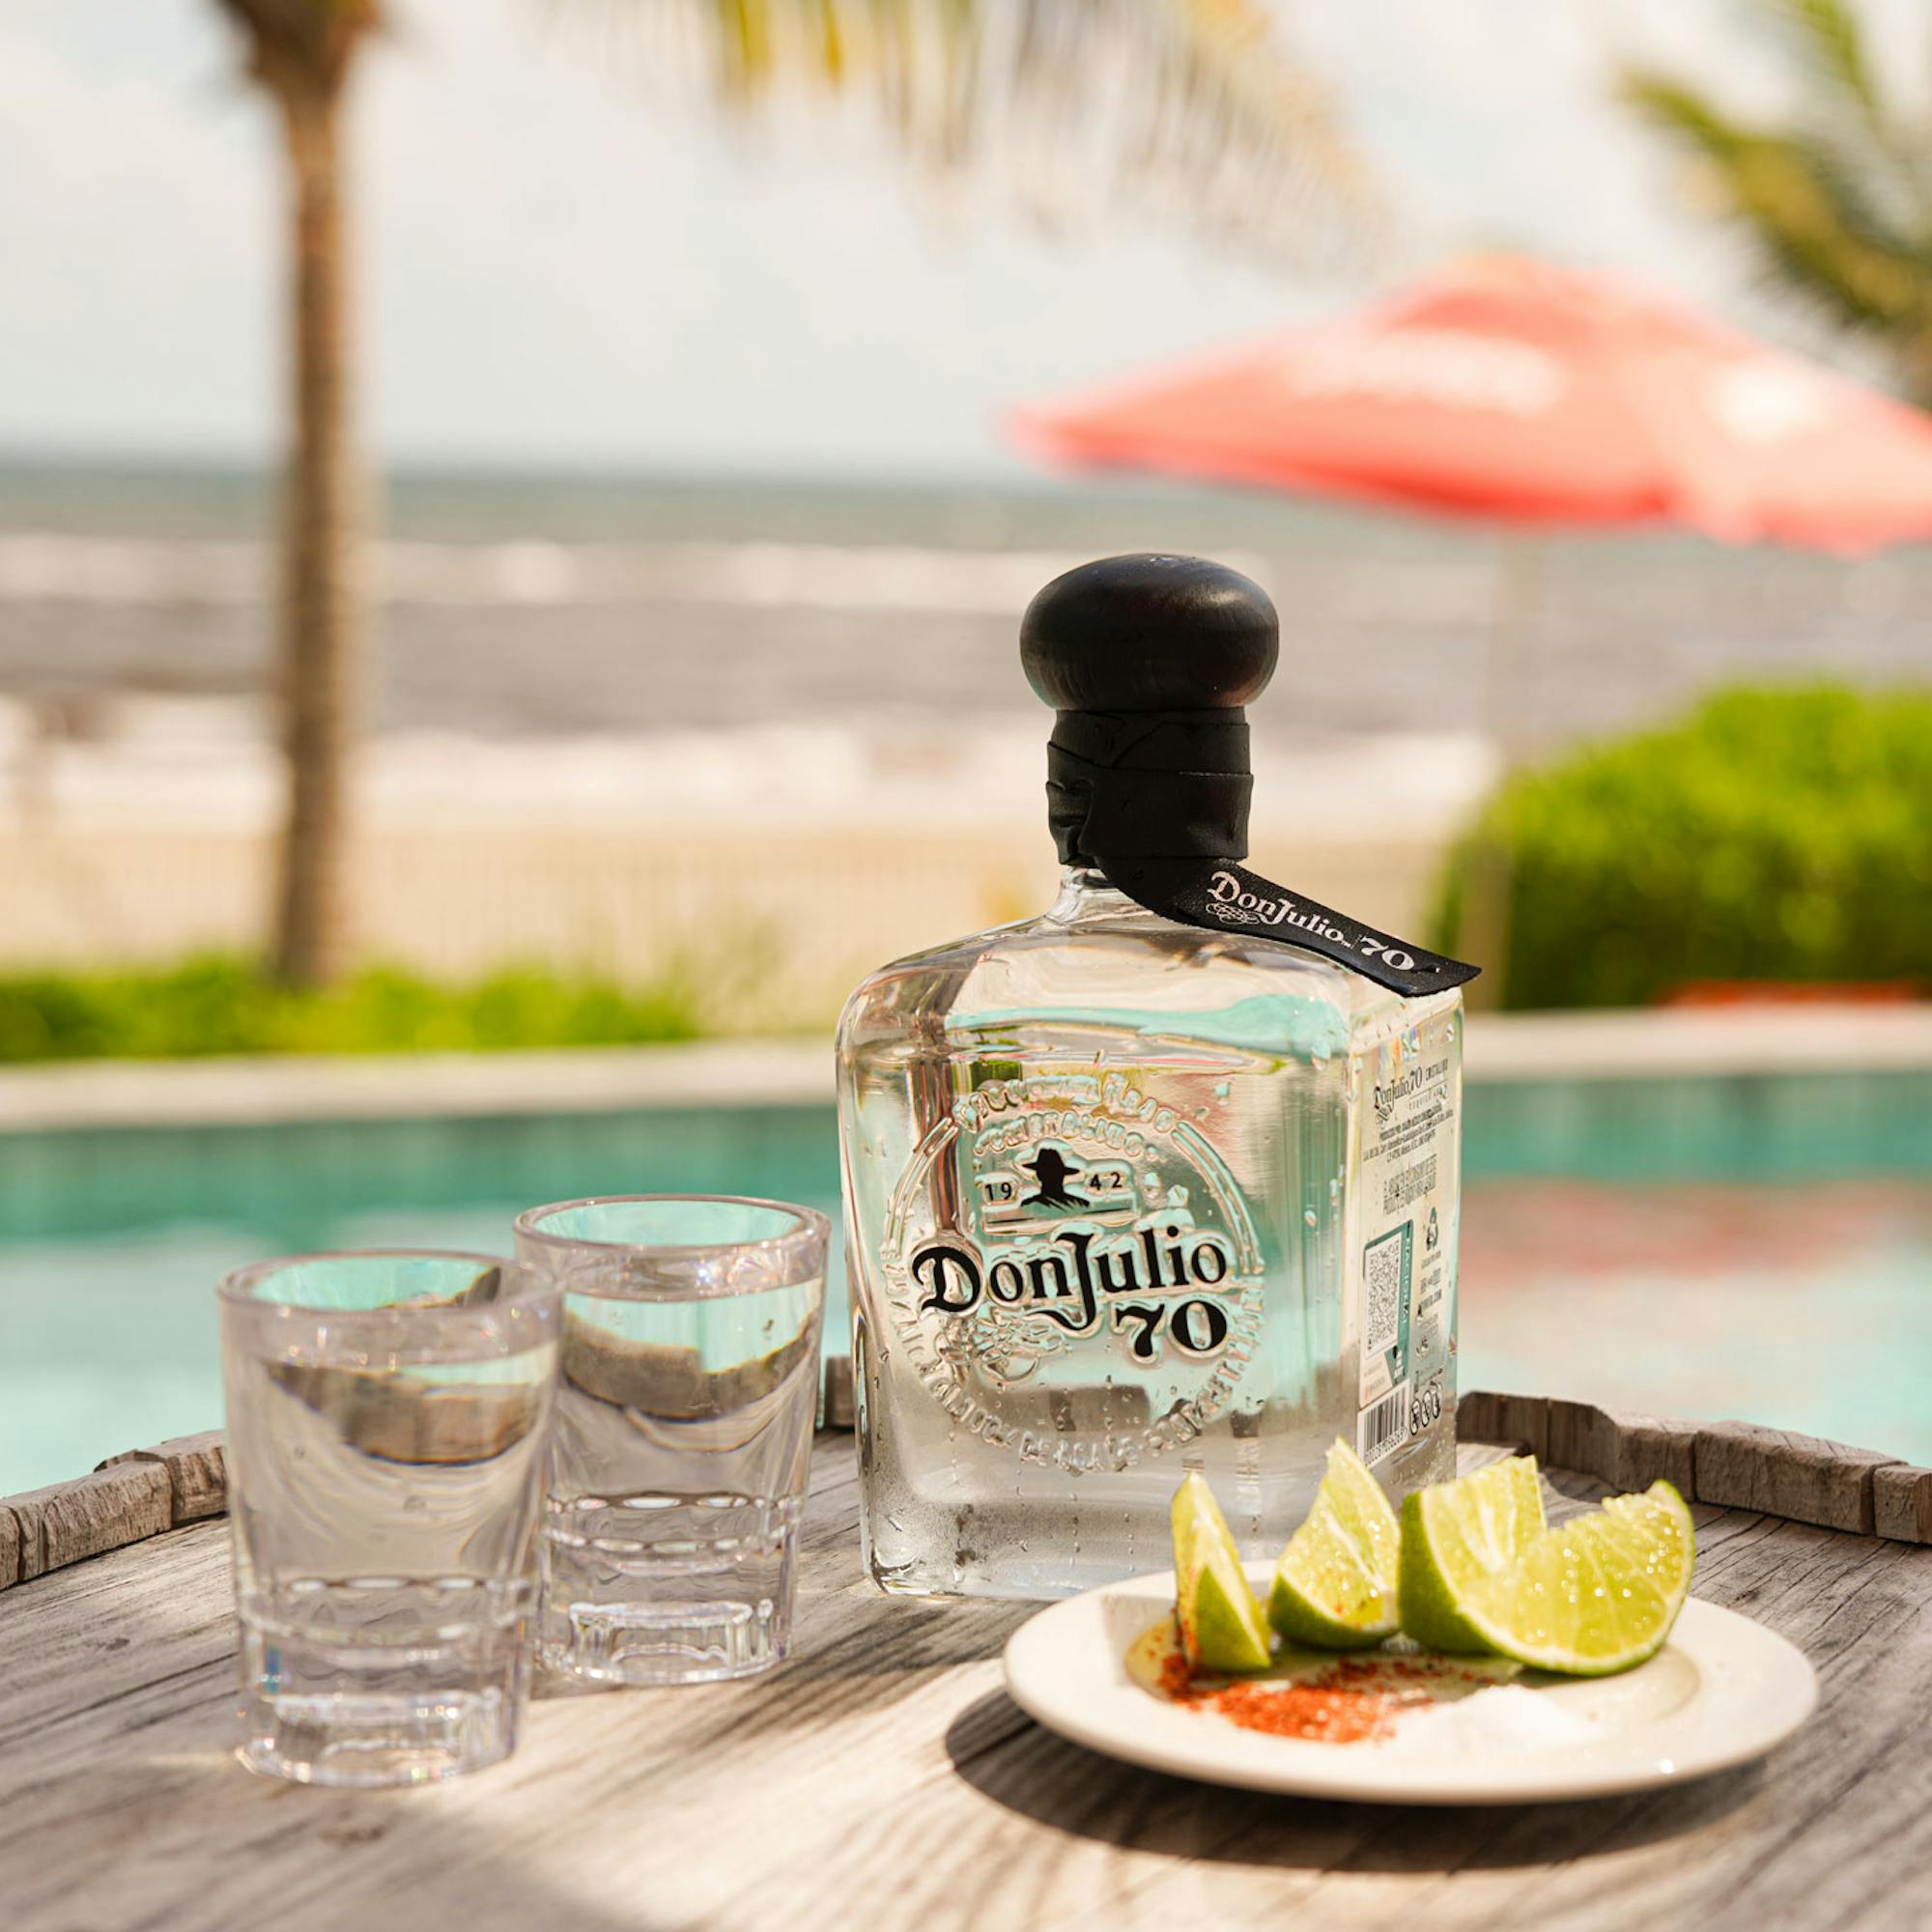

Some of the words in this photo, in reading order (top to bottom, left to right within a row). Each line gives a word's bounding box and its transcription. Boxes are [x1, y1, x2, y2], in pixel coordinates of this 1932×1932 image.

[1361, 935, 1415, 971] 70
[983, 1181, 1012, 1202] 19
[1089, 1171, 1122, 1191] 42
[1114, 1299, 1228, 1358] 70
